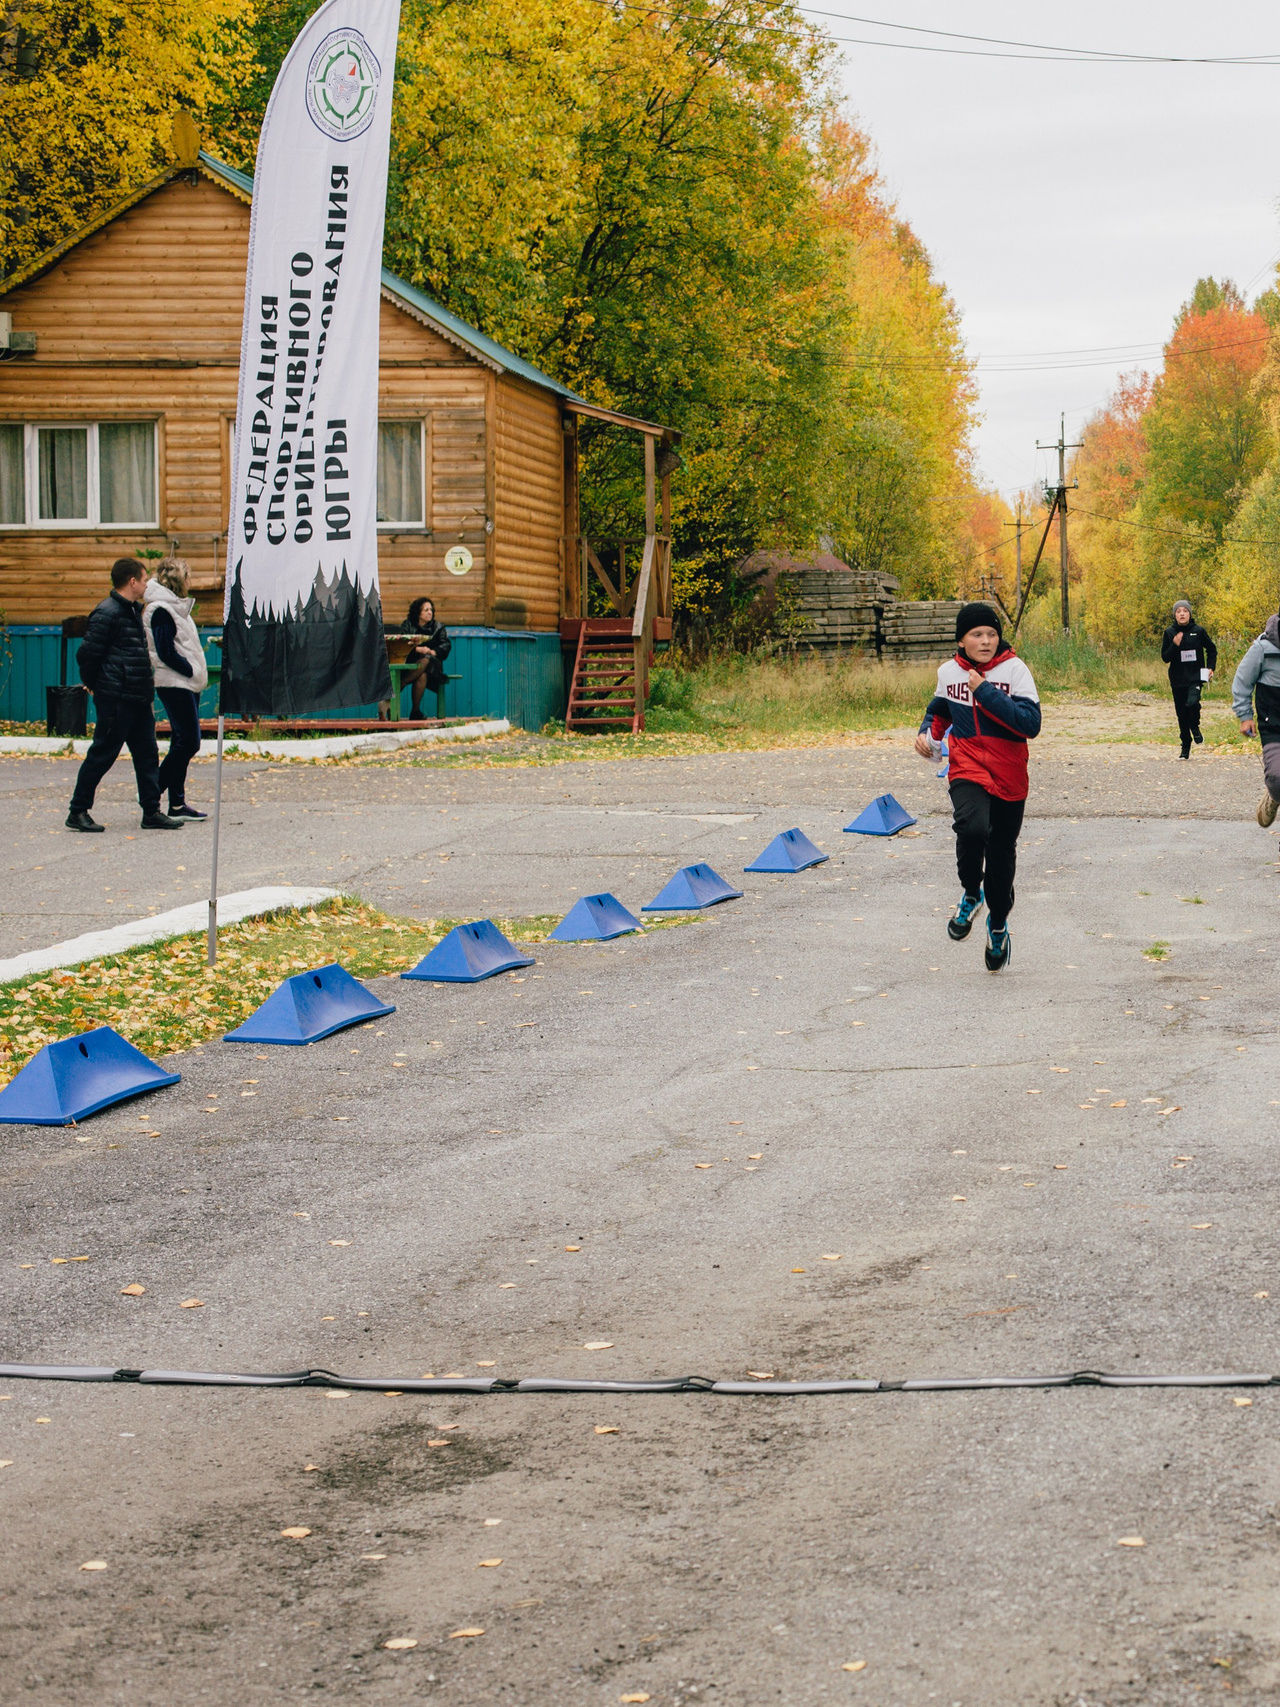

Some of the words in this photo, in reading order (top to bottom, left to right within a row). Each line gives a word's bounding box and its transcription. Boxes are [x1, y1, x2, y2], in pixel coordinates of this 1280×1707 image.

[243, 295, 279, 545] ФЕДЕРАЦИЯ
[266, 252, 314, 545] СПОРТИВНОГО
[324, 419, 351, 541] ЮГРЫ
